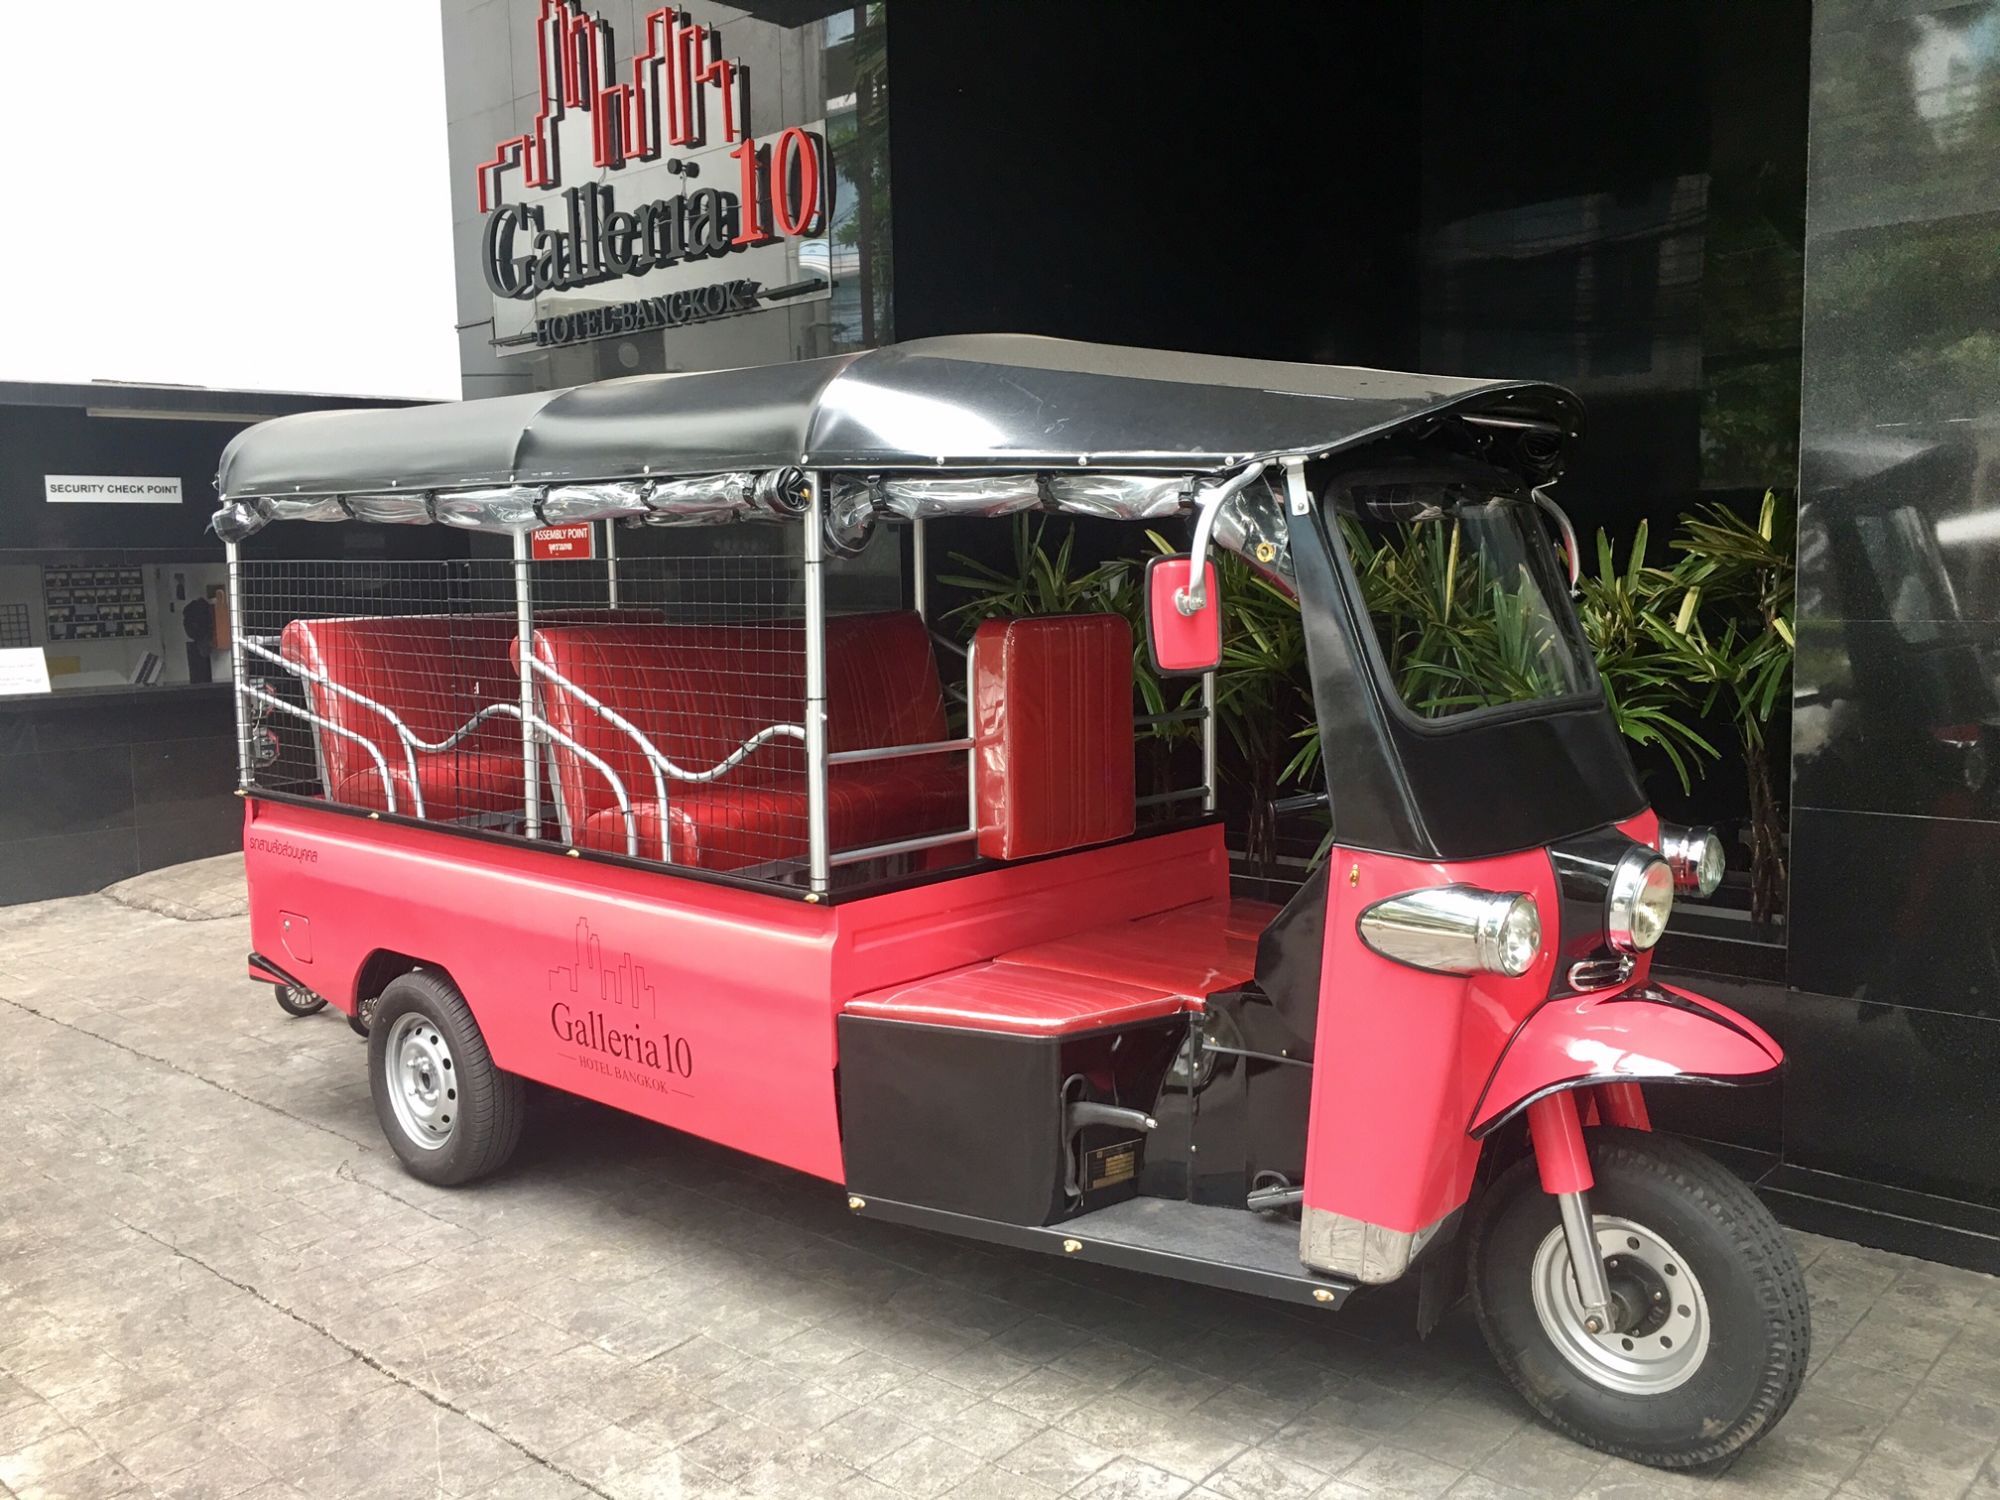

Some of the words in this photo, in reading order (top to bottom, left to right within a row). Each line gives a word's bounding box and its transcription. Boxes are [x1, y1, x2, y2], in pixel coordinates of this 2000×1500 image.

[482, 127, 819, 299] Galleria10
[536, 306, 615, 346] HOTEL
[621, 280, 744, 332] BANGKOK
[50, 484, 104, 493] SECURITY
[107, 484, 145, 494] CHECK
[147, 485, 178, 494] POINT
[535, 529, 567, 541] ASSEMBLY
[568, 528, 588, 539] POINT
[551, 1002, 693, 1078] Galleria10
[579, 1055, 612, 1077] HOTEL
[615, 1068, 668, 1094] BANGKOK
